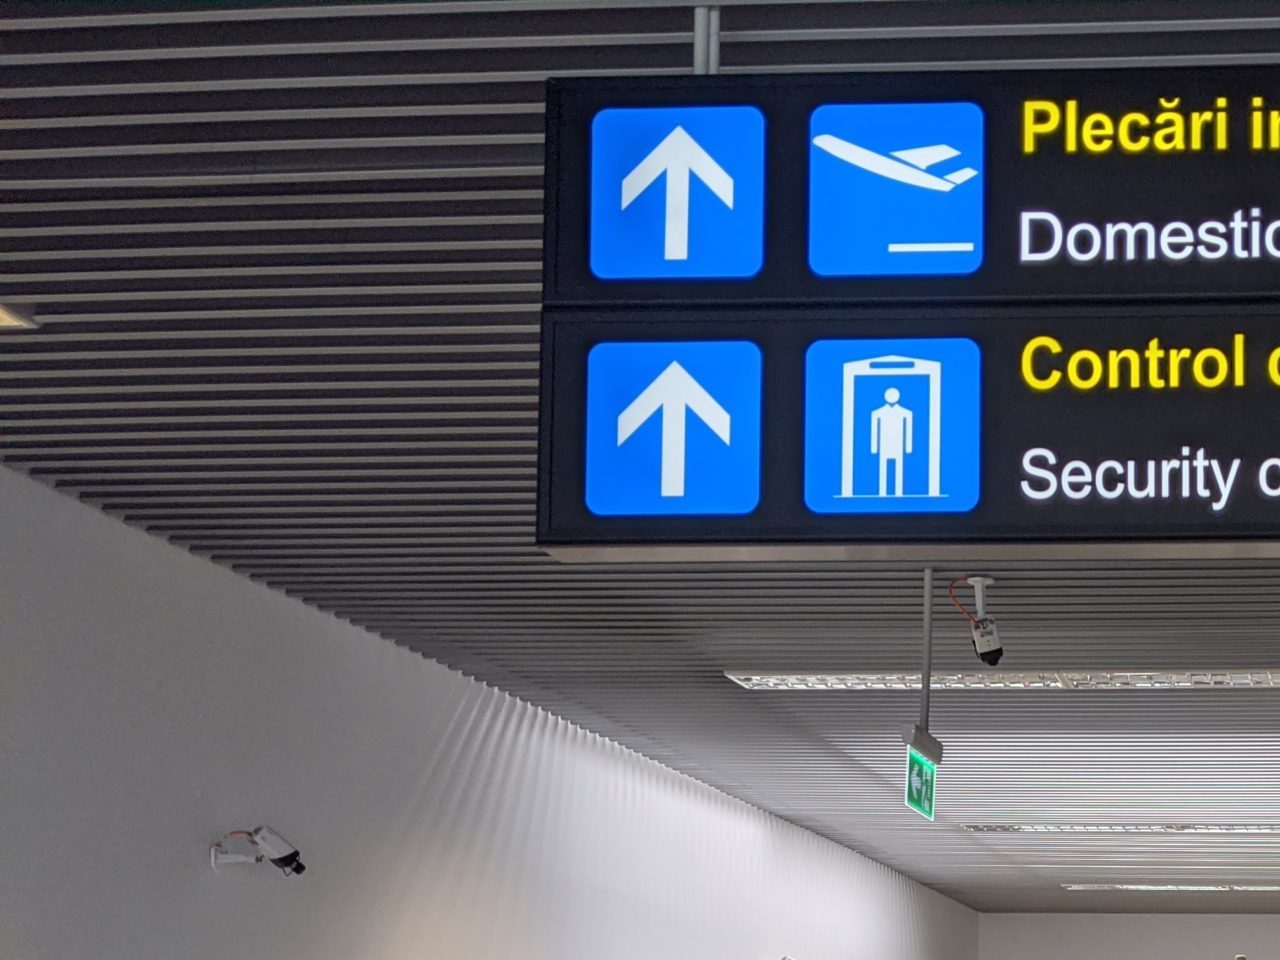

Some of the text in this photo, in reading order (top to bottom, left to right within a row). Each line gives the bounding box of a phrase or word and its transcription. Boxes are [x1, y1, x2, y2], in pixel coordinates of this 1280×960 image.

[1021, 95, 1229, 155] Plecări
[1020, 331, 1246, 392] Control
[1019, 444, 1241, 512] Security
